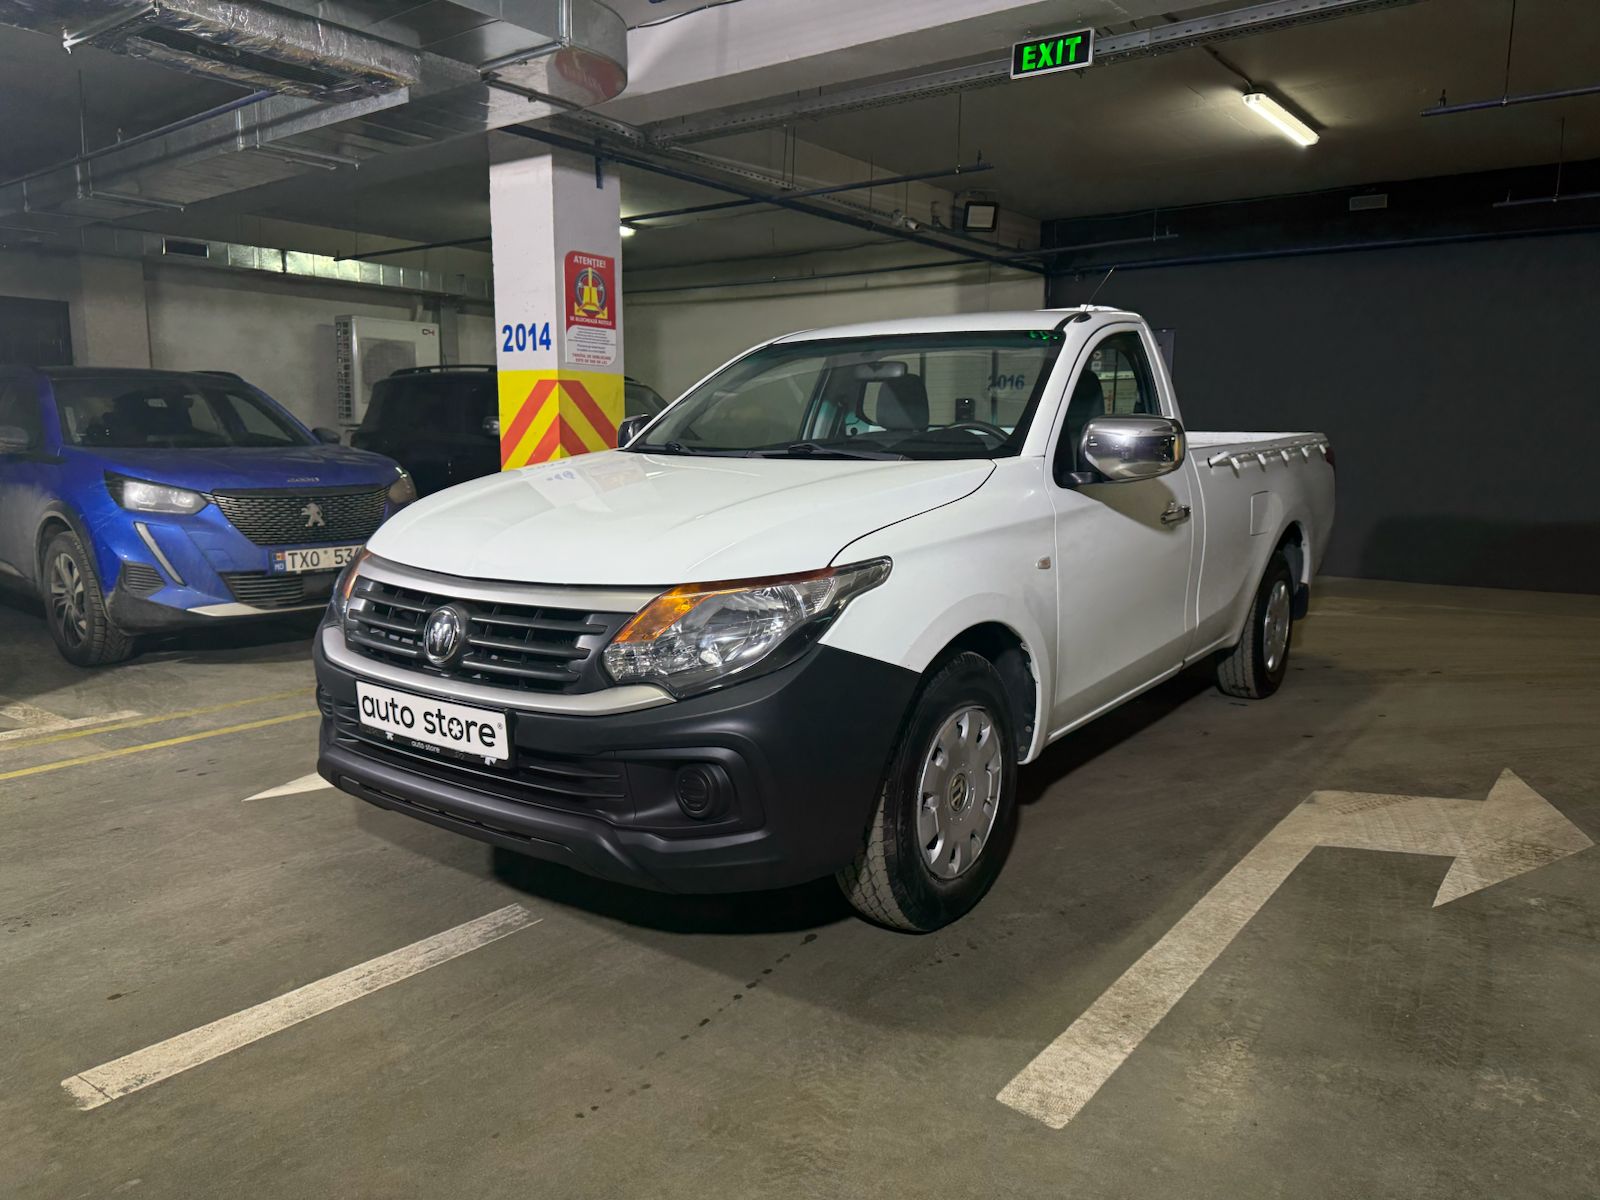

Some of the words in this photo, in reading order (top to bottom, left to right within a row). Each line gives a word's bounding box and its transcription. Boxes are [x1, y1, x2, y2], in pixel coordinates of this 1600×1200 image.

[1022, 36, 1082, 71] EXIT
[502, 322, 551, 352] 2014
[362, 695, 415, 729] auto
